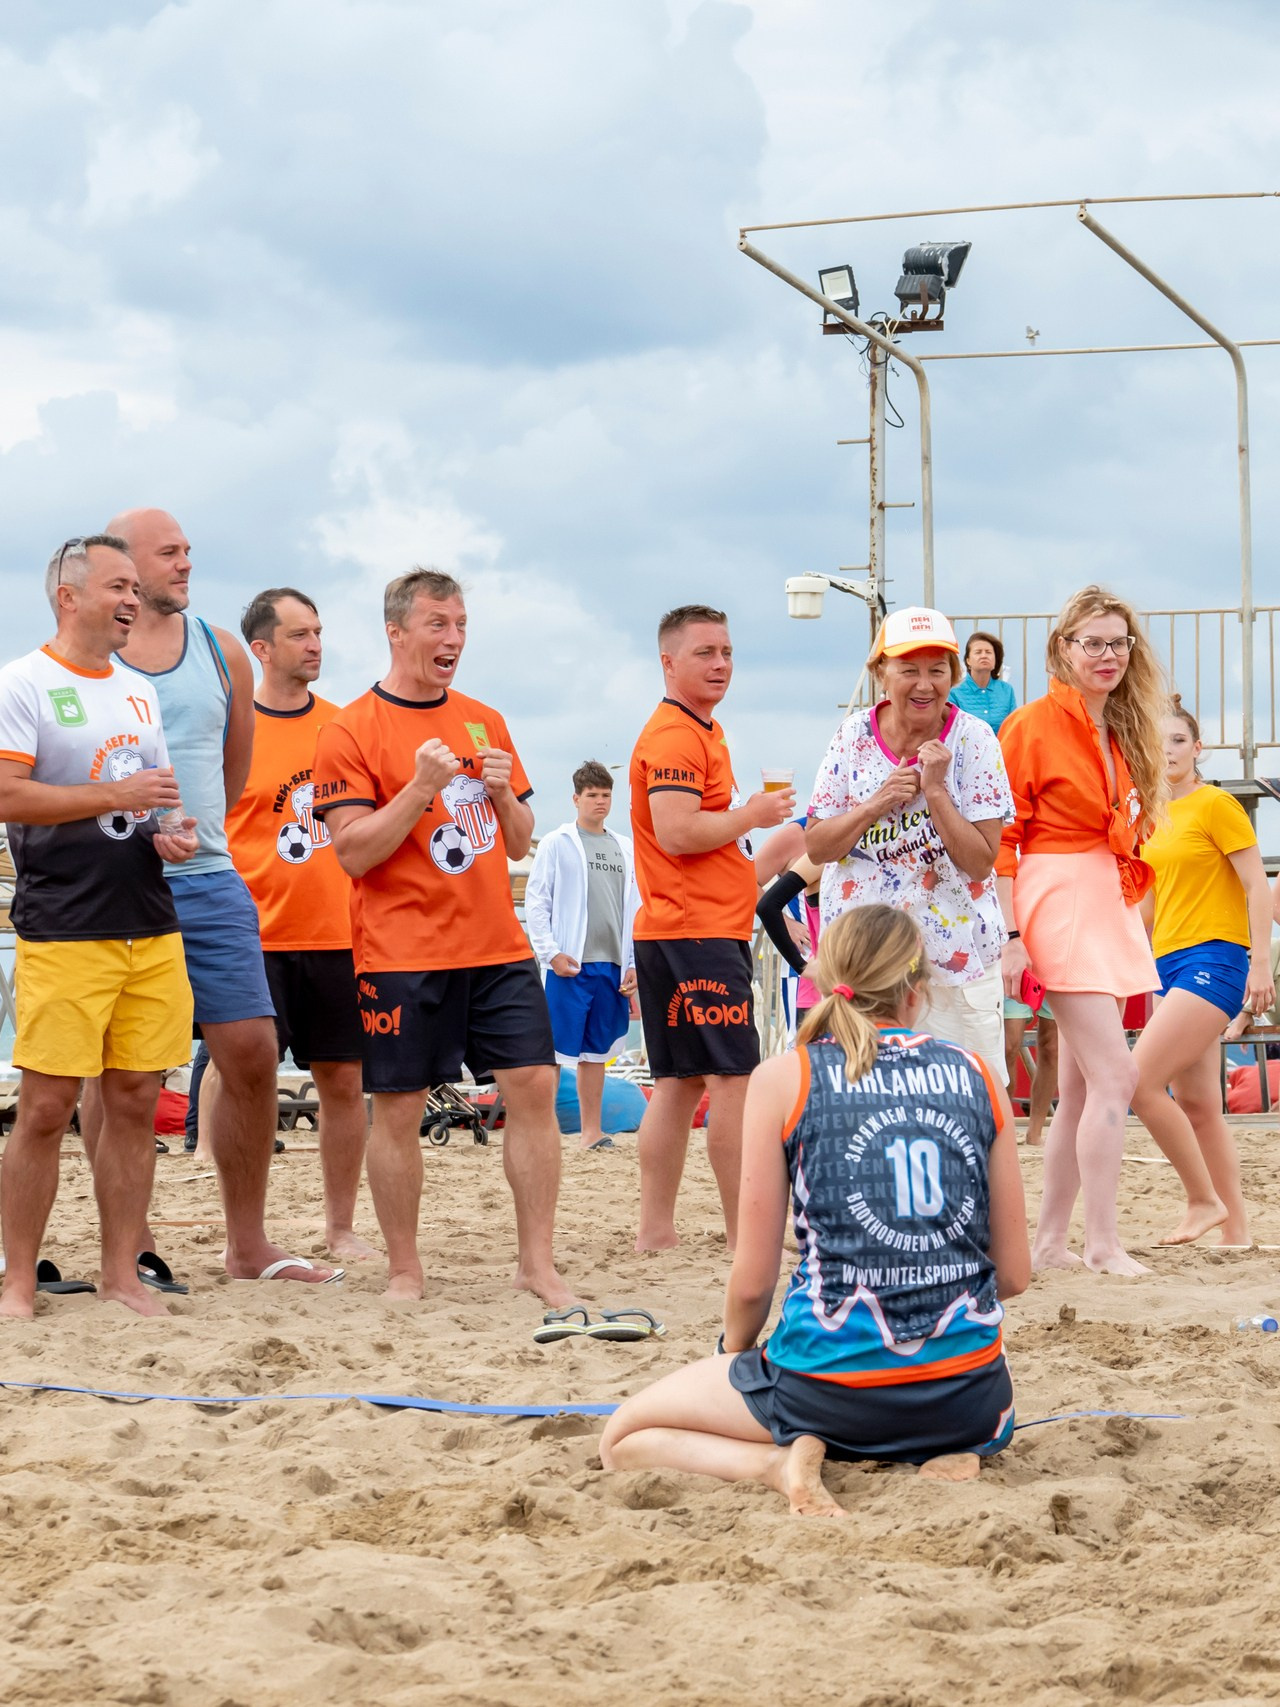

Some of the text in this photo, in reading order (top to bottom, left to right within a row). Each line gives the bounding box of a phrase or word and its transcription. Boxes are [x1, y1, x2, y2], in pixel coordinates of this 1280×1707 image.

[89, 733, 139, 781] ПЕЙ-БЕГИ
[273, 768, 313, 813] ПЕЙ-БЕГ
[313, 779, 347, 799] ЕДИЛ
[587, 861, 623, 873] TRONG
[595, 852, 608, 861] BE
[692, 1000, 749, 1028] БОЮ!
[844, 1105, 977, 1167] ЗАРЯЖАЕМ ЭМОЦИЯМИ
[884, 1137, 945, 1218] 10
[846, 1191, 975, 1252] ВДОХНОВЛЯЕМ НА ПОЕДЫ
[842, 1262, 980, 1288] WWW.INTELSPORTRU
